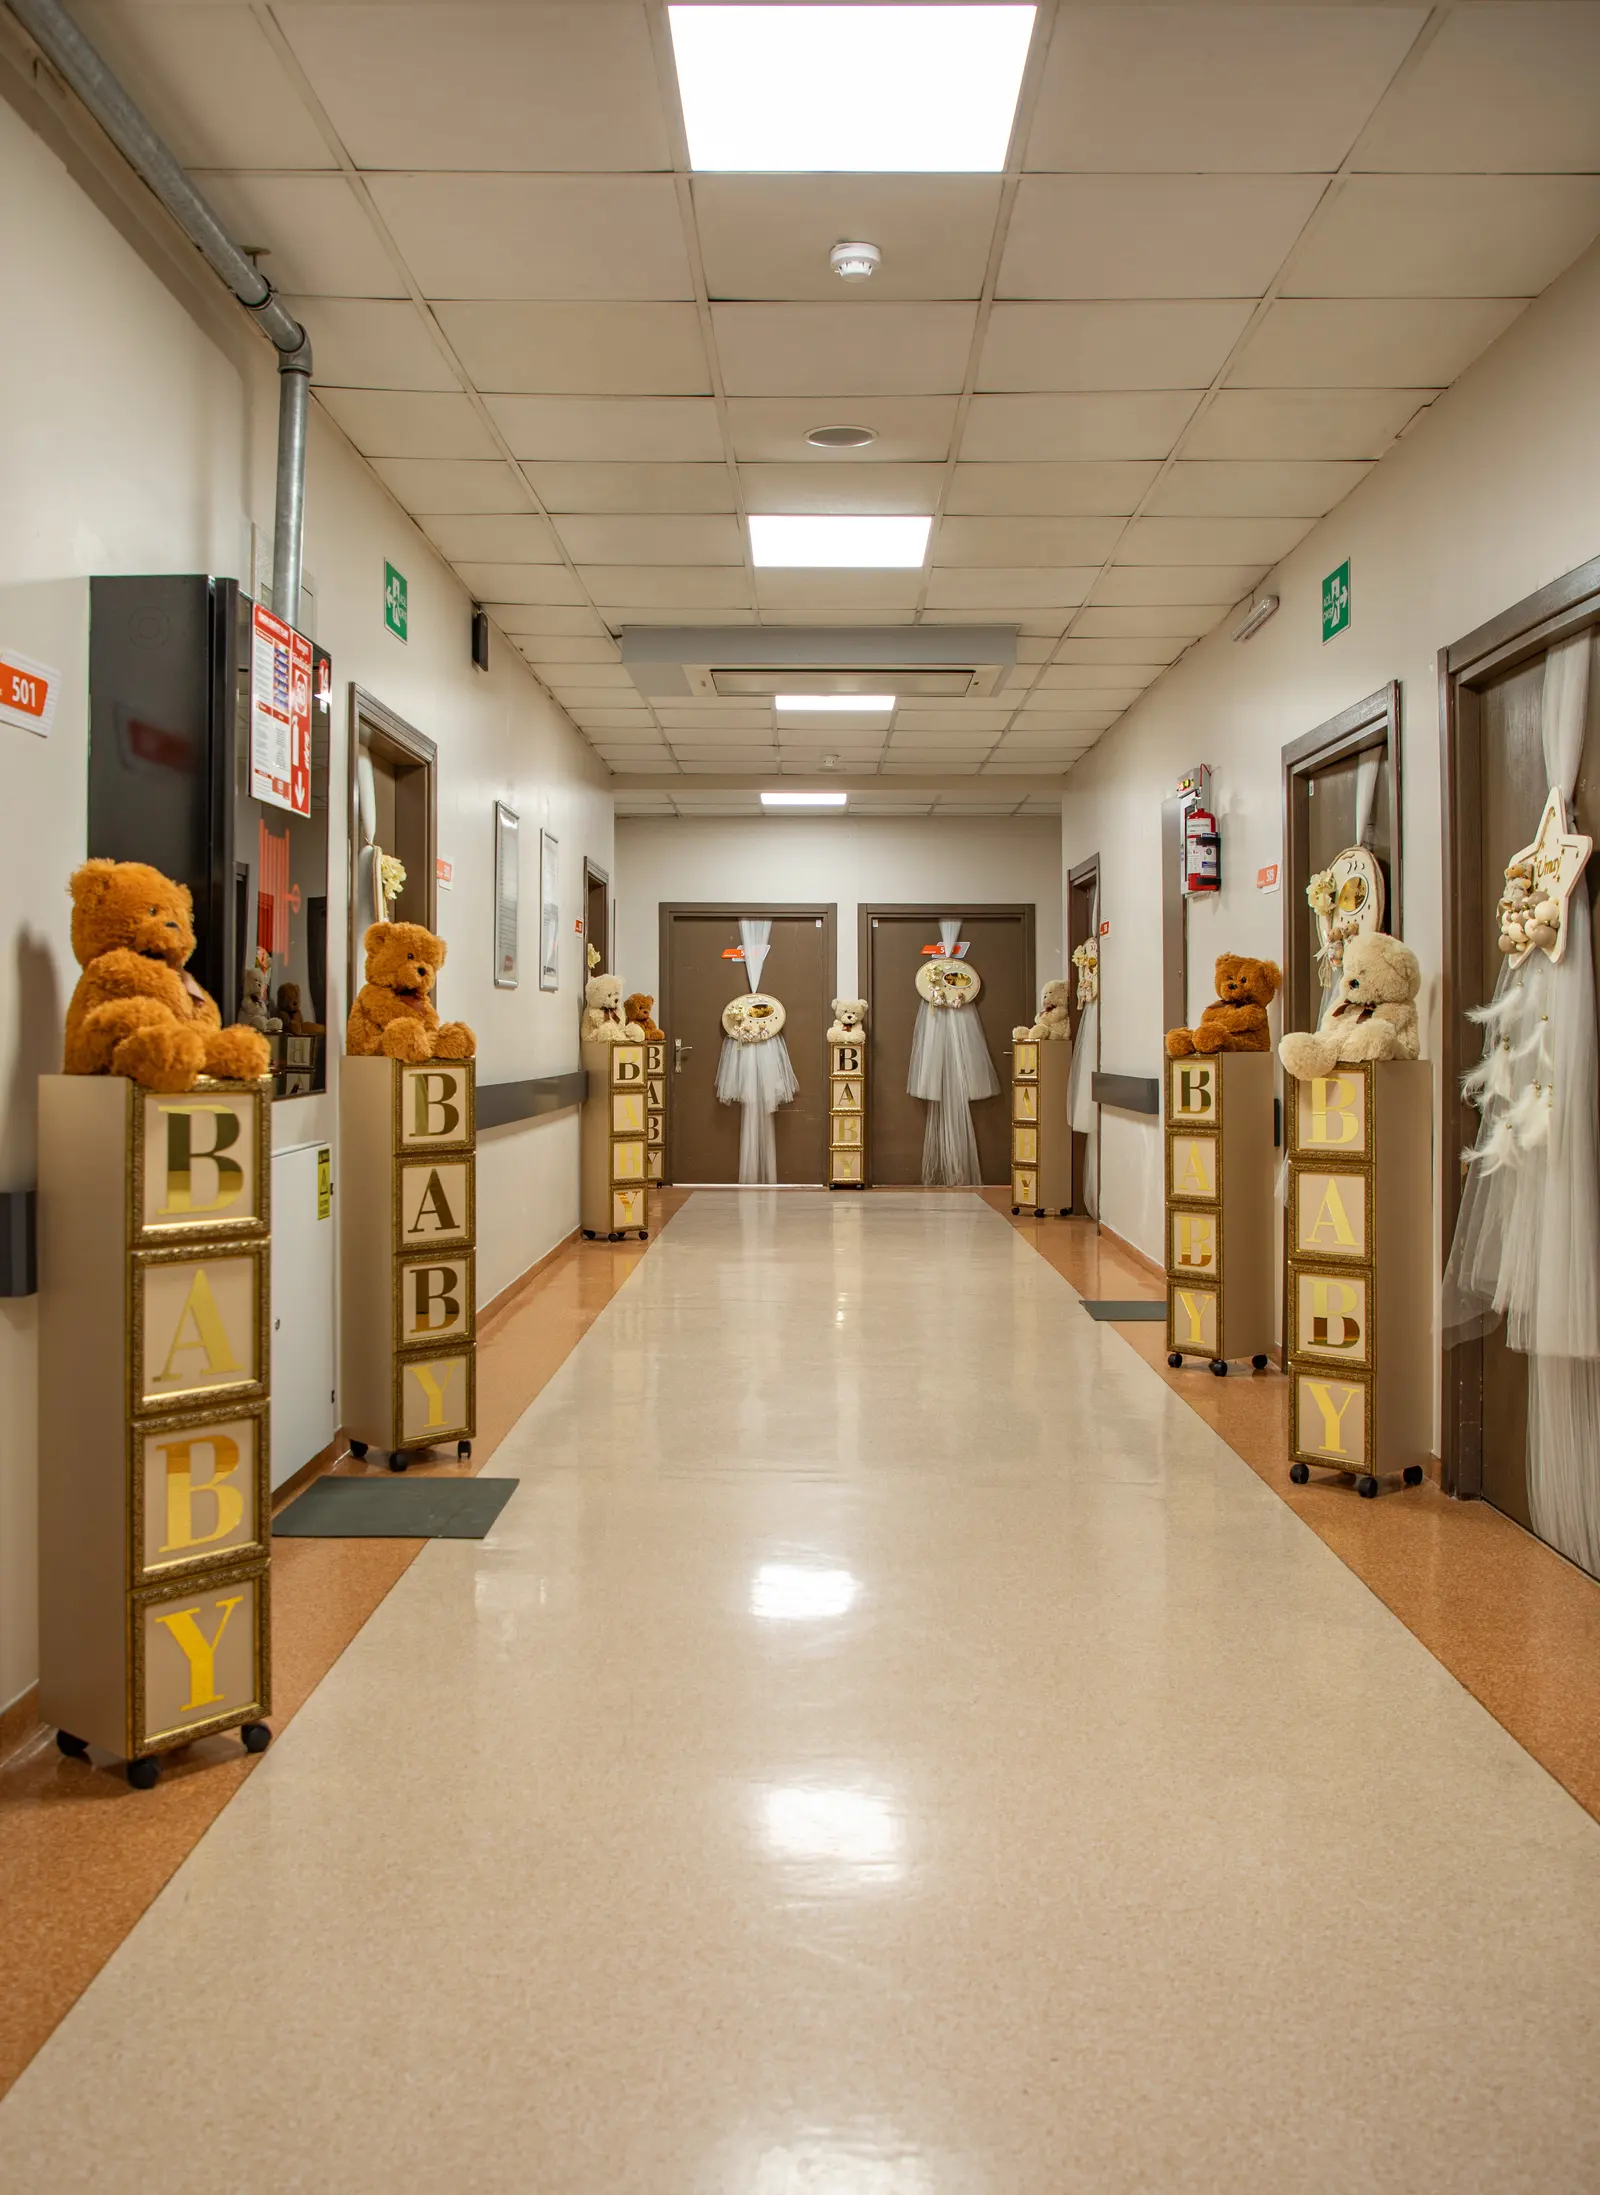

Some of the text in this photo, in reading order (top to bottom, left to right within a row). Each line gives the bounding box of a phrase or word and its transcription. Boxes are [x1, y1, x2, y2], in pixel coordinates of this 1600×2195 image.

[12, 676, 36, 707] 501
[408, 1072, 461, 1429] BABY
[836, 1047, 859, 1177] BABY
[1177, 1064, 1213, 1344] BABY
[1303, 1077, 1361, 1455] BABY
[153, 1104, 245, 1713] BABY
